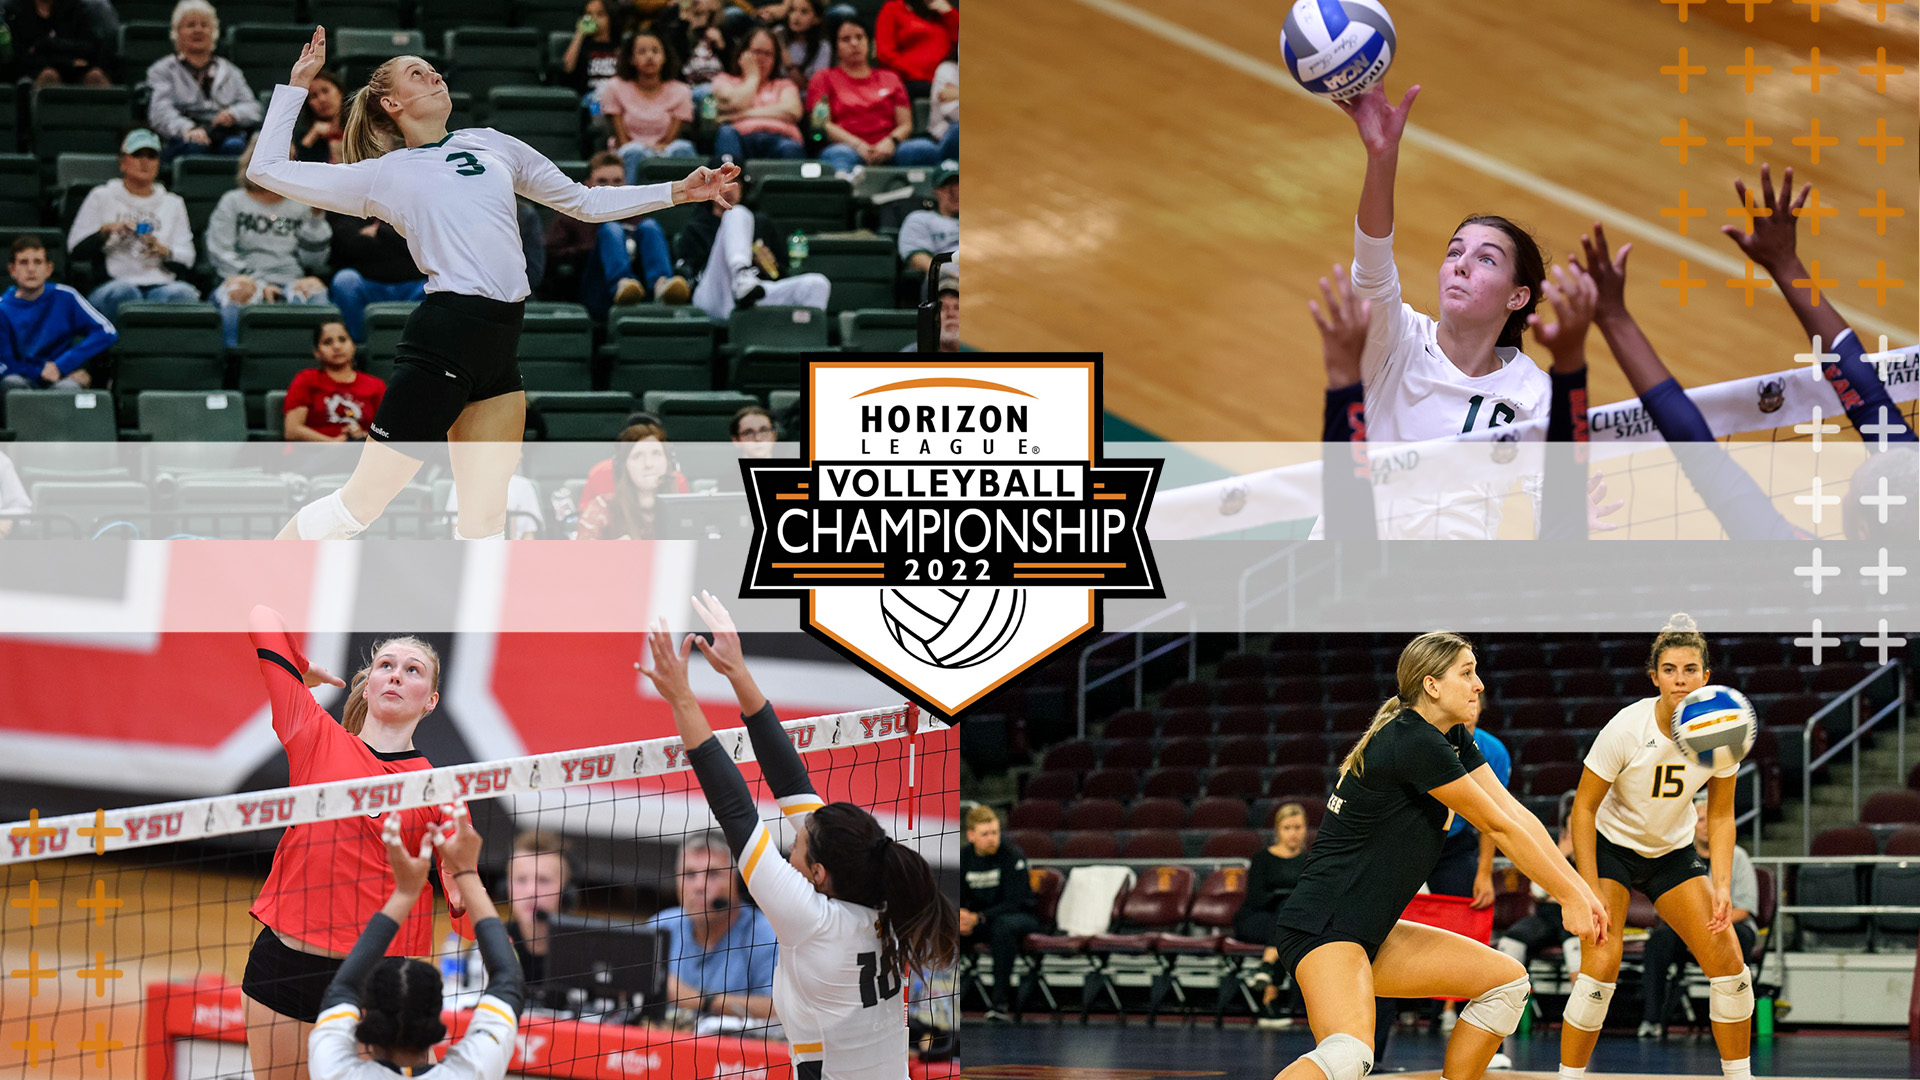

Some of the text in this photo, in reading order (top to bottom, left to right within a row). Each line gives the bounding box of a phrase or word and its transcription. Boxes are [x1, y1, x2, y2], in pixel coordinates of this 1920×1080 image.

[445, 151, 486, 177] 3
[124, 811, 184, 841] YSU
[237, 796, 296, 826] YSU
[347, 781, 405, 811] YSU
[454, 767, 512, 796] YSU
[561, 753, 616, 783] YSU
[859, 709, 909, 739] YSU
[1651, 764, 1686, 799] 15
